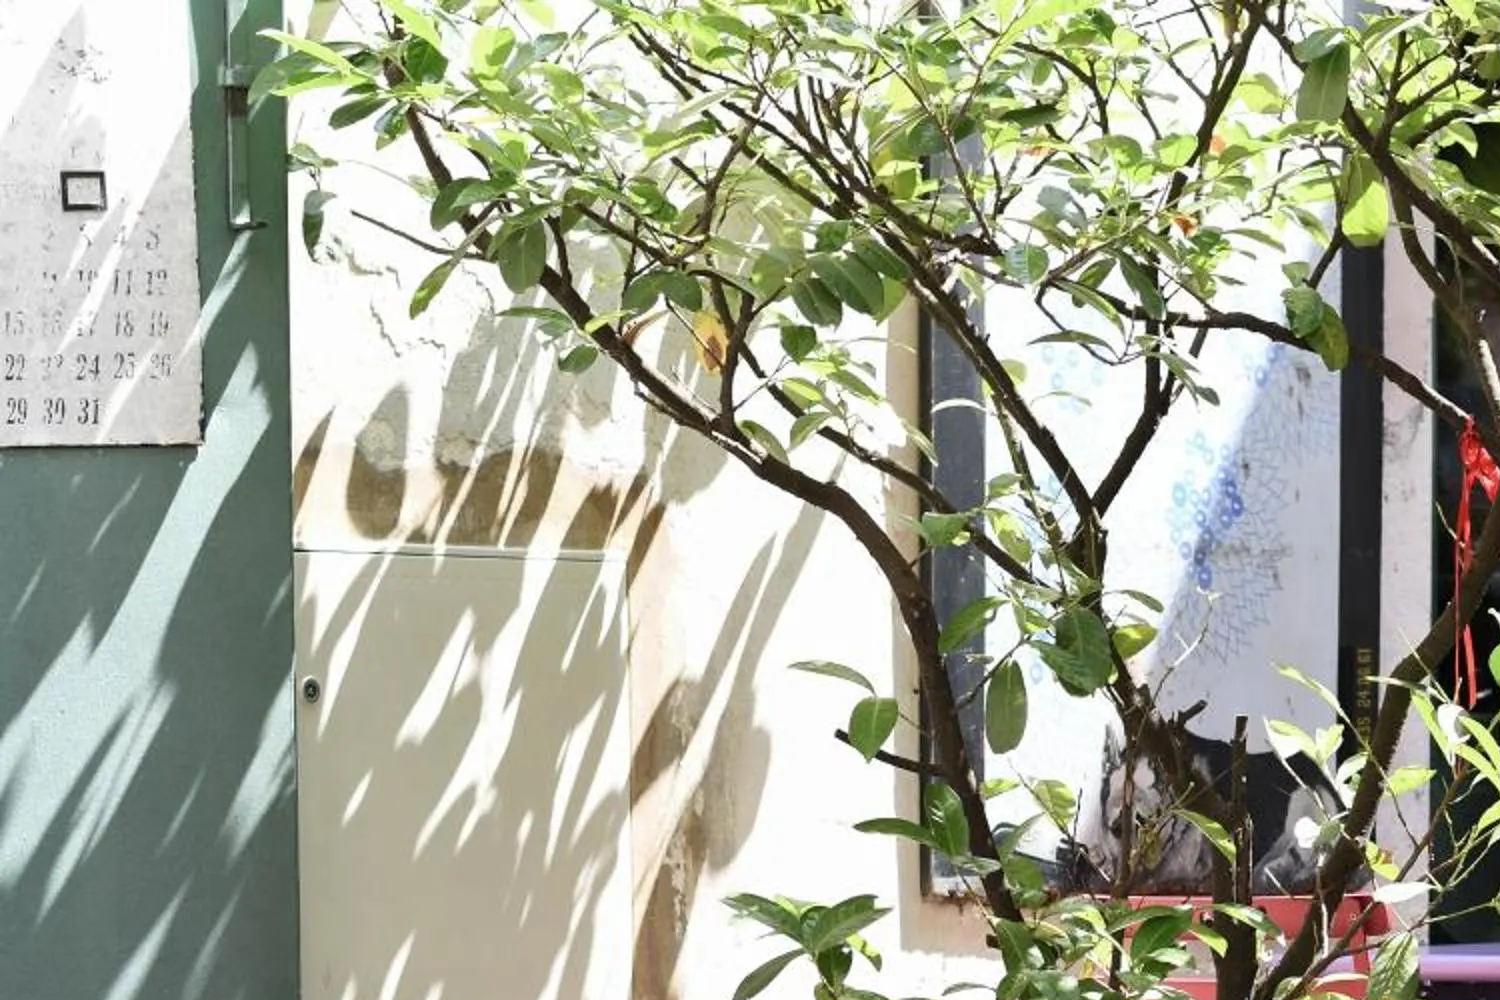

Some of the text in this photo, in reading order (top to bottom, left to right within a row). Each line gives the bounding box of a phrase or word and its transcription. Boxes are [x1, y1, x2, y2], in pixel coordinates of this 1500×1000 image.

[114, 311, 135, 337] 18
[5, 353, 26, 381] 22
[76, 353, 100, 381] 24
[113, 352, 136, 379] 25
[6, 397, 100, 425] 29 30 31
